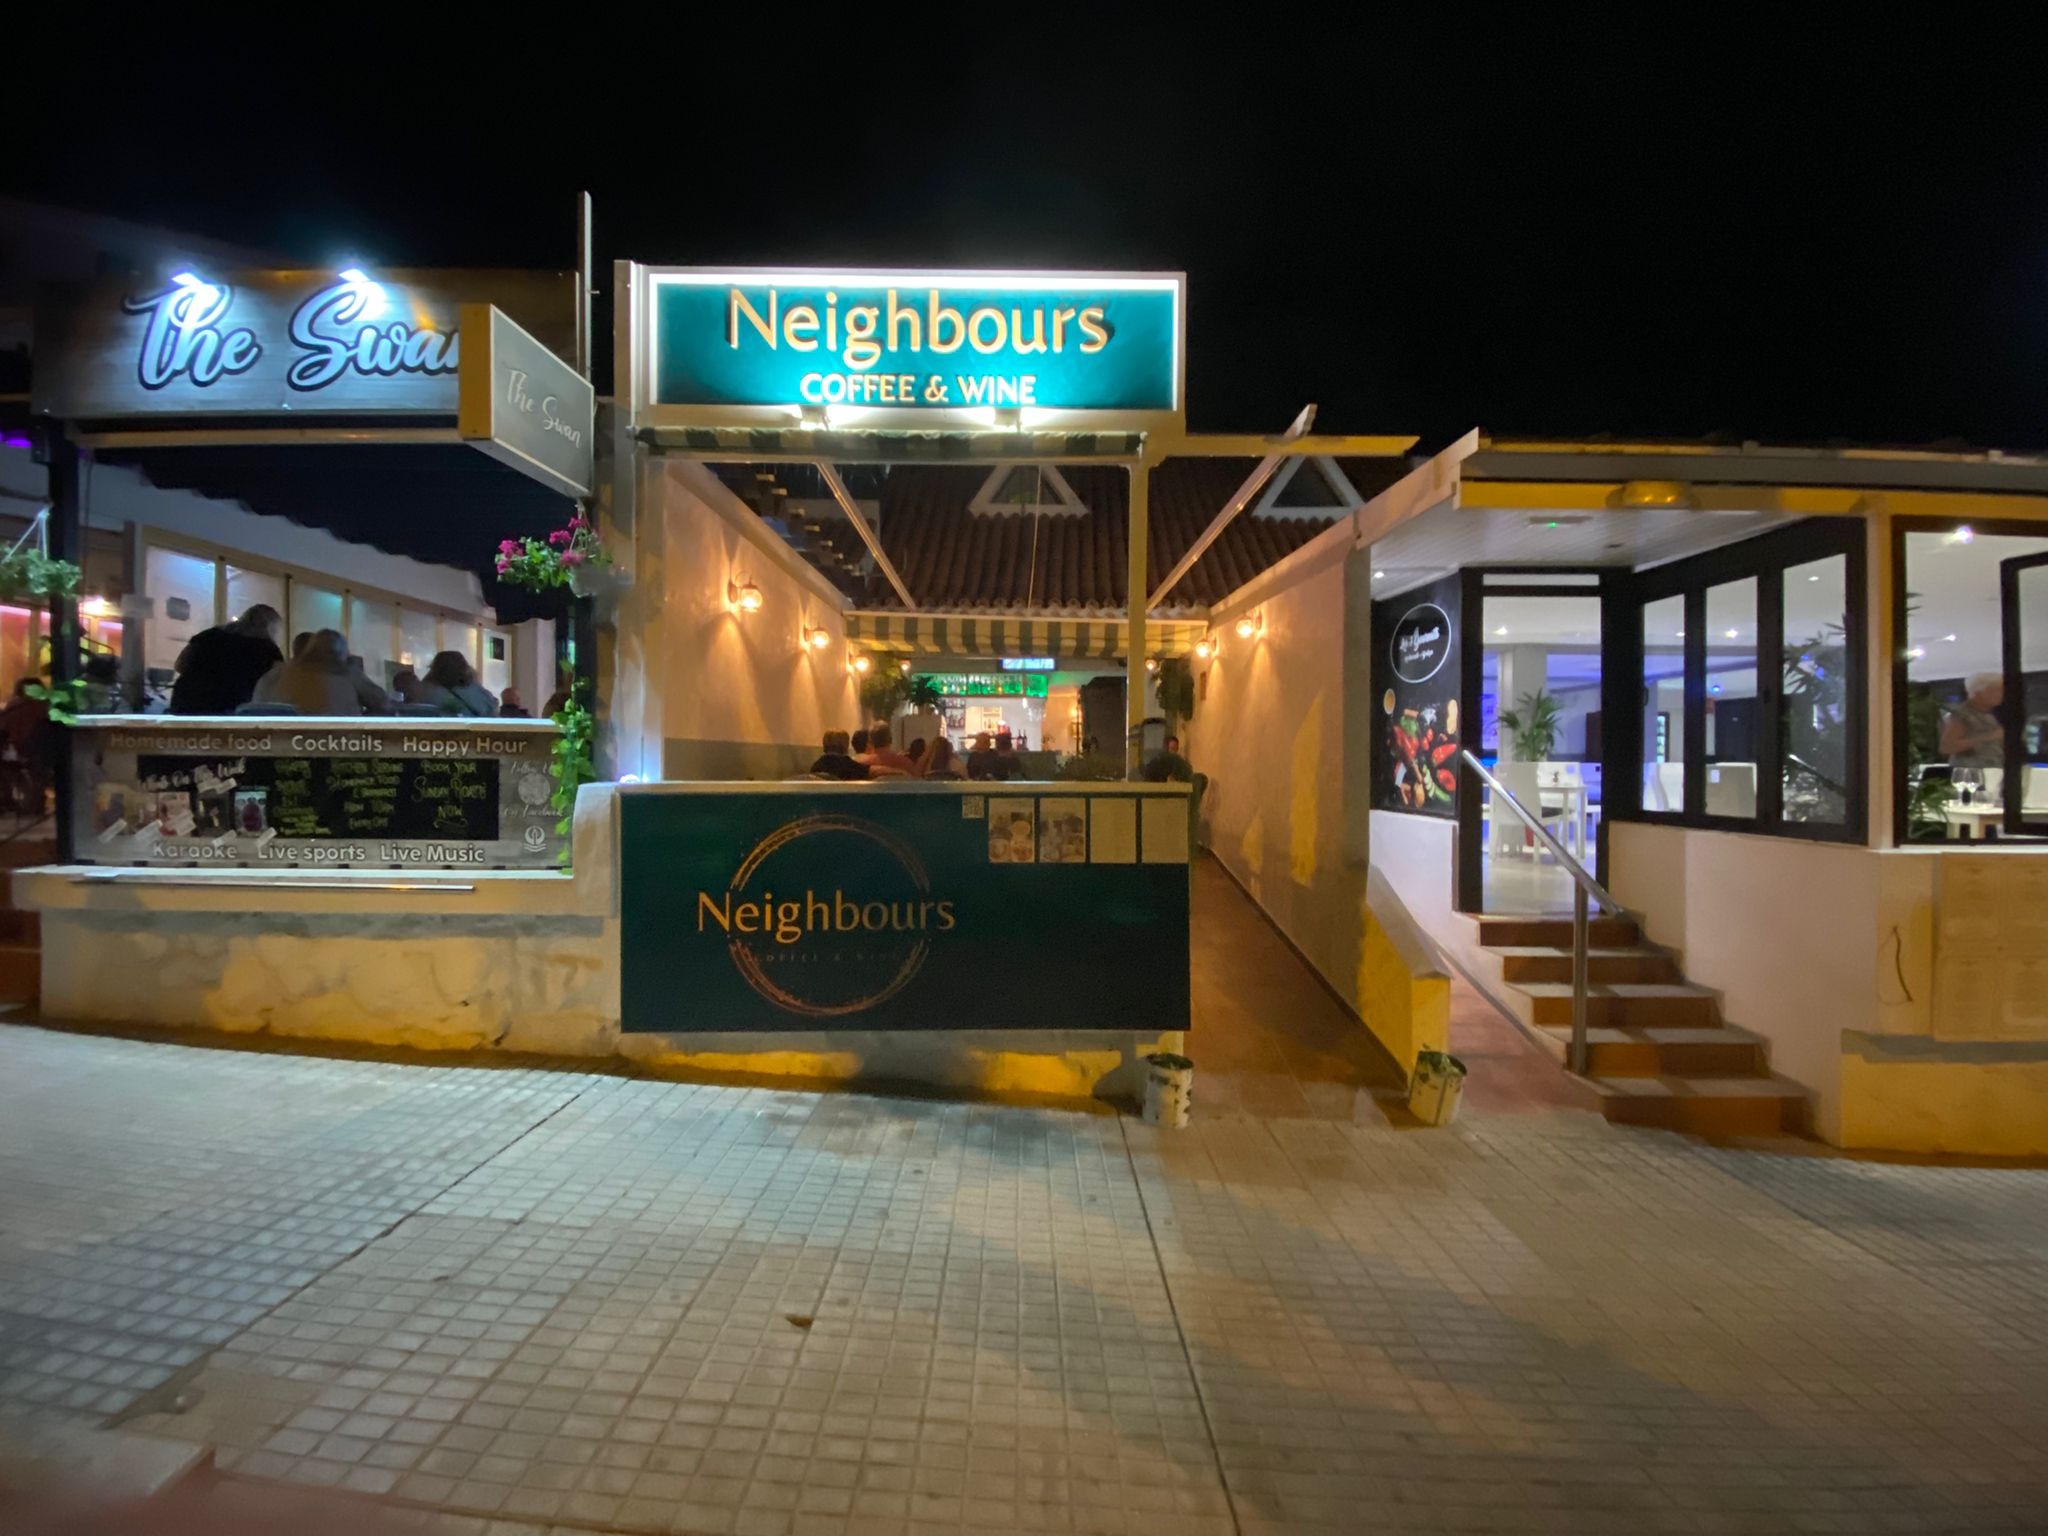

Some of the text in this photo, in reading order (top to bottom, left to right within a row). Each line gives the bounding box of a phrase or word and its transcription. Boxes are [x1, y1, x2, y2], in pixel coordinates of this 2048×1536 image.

[121, 282, 263, 390] The
[727, 287, 1110, 370] Neighbours
[800, 372, 1036, 403] COFFEE & WINE
[505, 368, 581, 447] The Swan
[111, 733, 272, 751] Homemade food
[291, 734, 383, 752] Cocktails
[403, 735, 528, 756] Happy Hour
[152, 843, 238, 859] Karaoke
[258, 843, 365, 863] Live sports
[380, 844, 484, 862] Live Music
[696, 889, 956, 944] Neighbours
